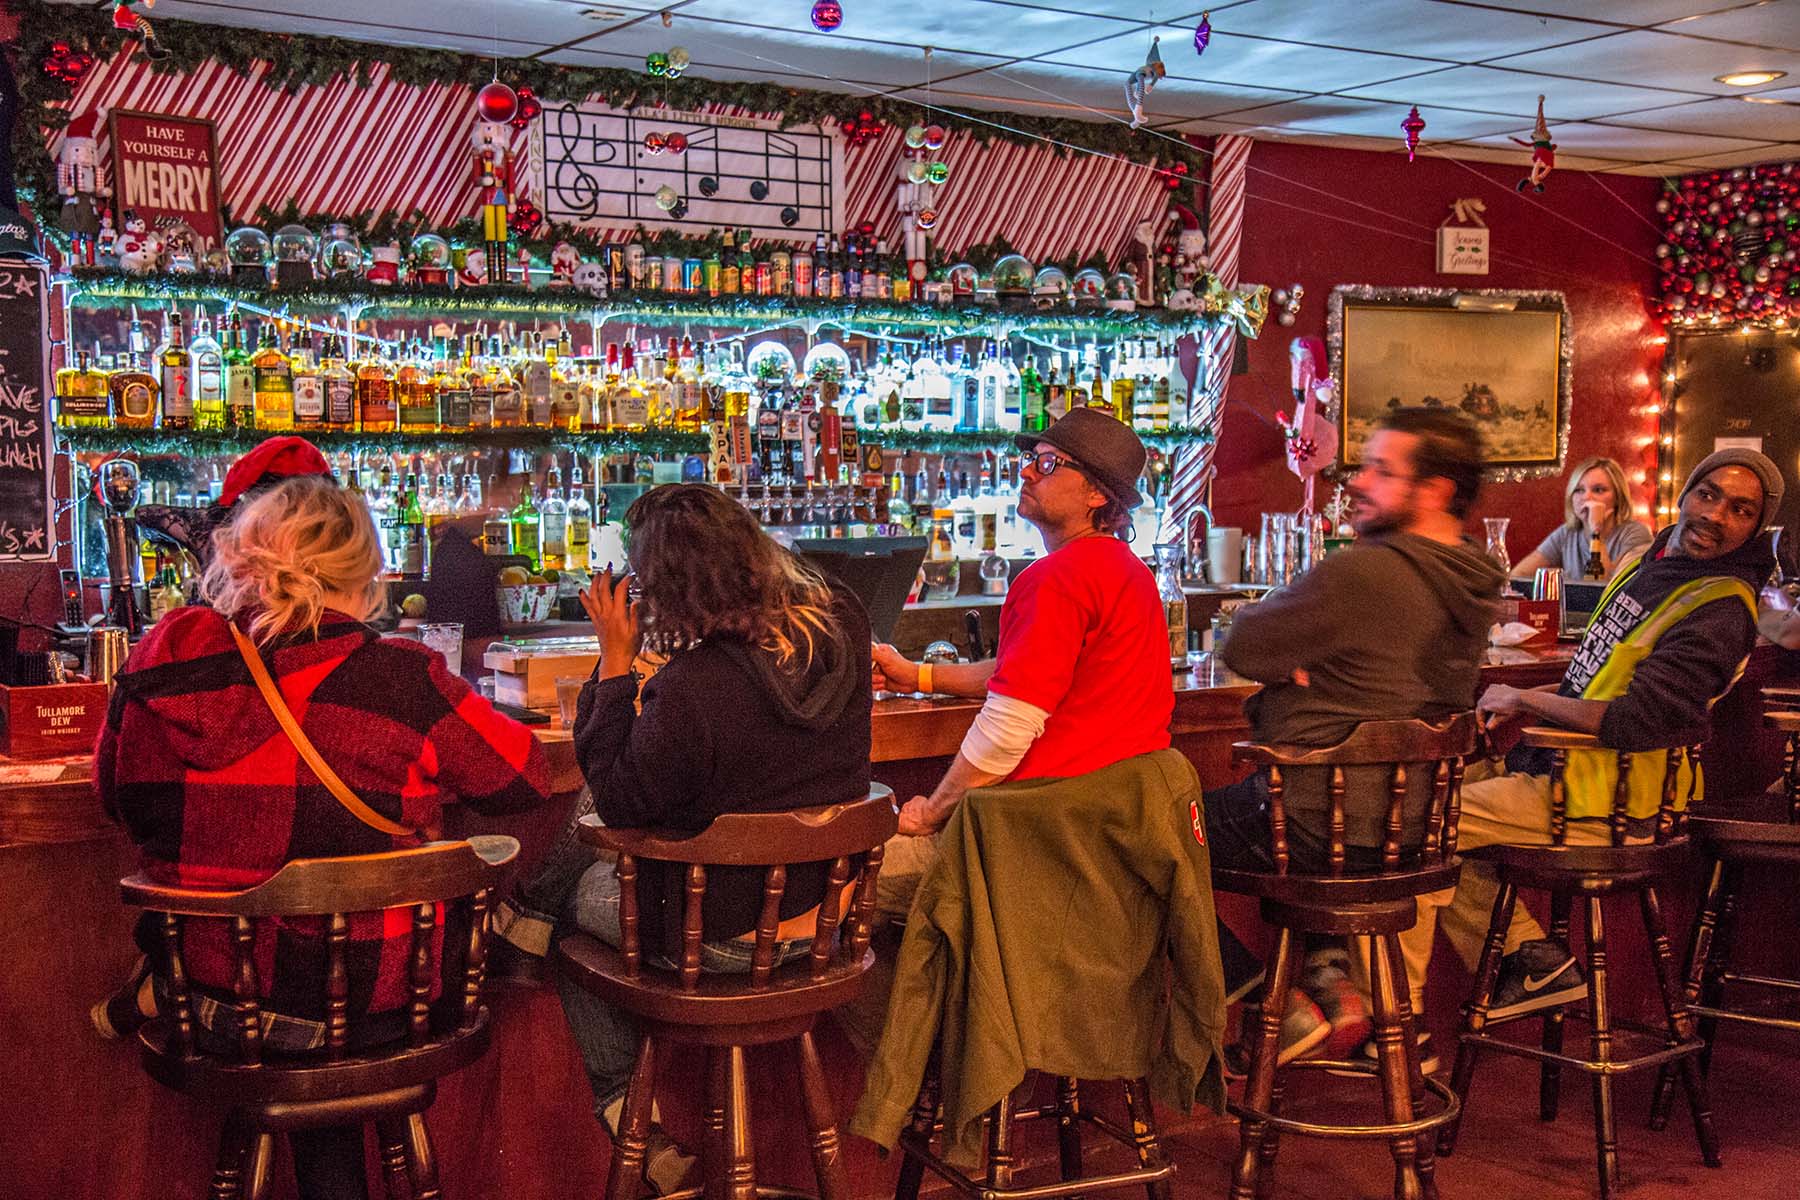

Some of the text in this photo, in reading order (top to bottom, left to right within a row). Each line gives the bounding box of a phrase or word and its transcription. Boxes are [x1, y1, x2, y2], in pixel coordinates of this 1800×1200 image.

[146, 125, 185, 142] HAVE
[123, 140, 208, 162] YOURSELF A
[123, 159, 212, 213] MERRY
[50, 716, 71, 727] DEW
